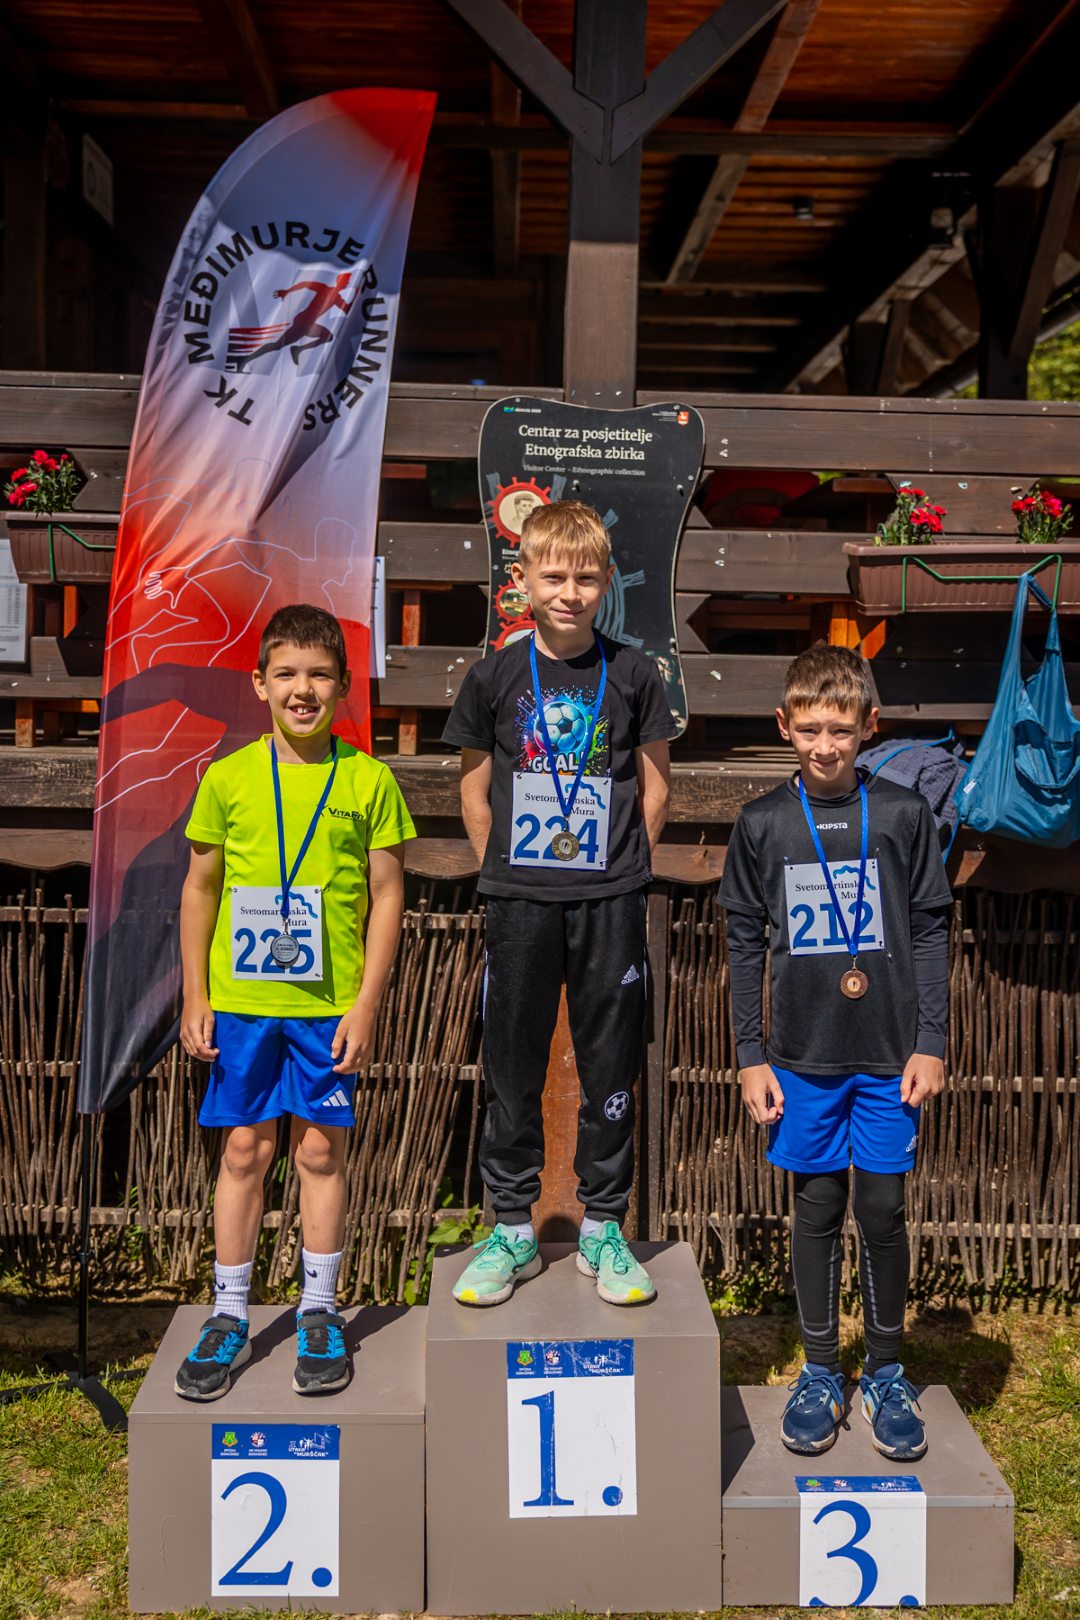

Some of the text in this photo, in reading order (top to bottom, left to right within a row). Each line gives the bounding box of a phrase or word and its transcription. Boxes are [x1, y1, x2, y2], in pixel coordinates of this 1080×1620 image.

[184, 221, 388, 430] TK MEĐIMURJE RUNNERS
[518, 424, 653, 444] Centar za posjetitelje
[525, 443, 645, 461] Etnografska zbirka
[522, 464, 543, 472] Visitor
[544, 465, 566, 473] Center
[572, 466, 614, 476] Ethnographic
[614, 468, 646, 476] collection
[524, 792, 595, 805] Svetomrnska
[513, 813, 599, 864] 224
[789, 900, 876, 948] 212
[234, 927, 315, 975] 225
[521, 1390, 624, 1507] 1.
[218, 1471, 333, 1588] 2.
